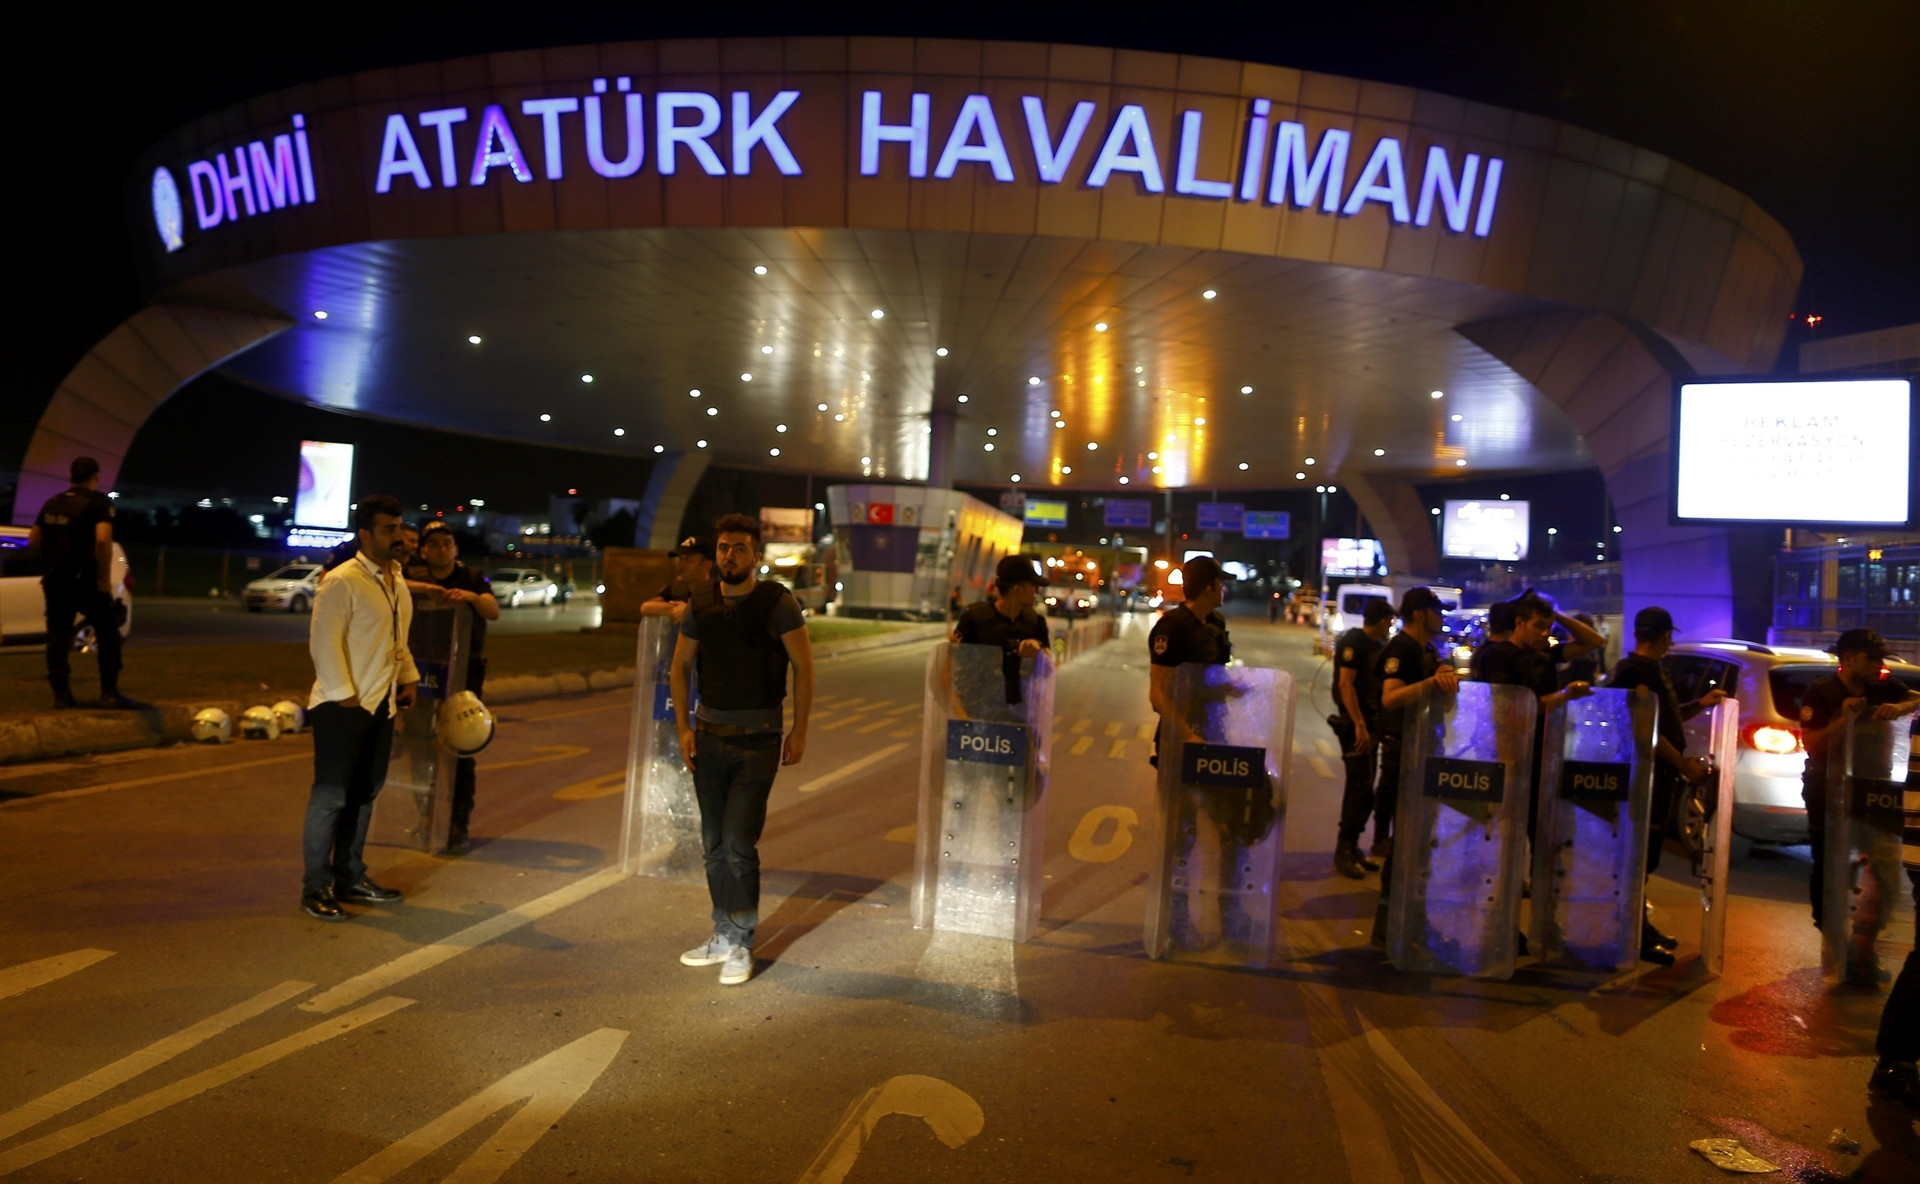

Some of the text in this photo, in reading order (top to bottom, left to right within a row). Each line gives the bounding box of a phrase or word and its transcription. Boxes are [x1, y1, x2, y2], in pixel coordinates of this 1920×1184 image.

[375, 76, 1504, 238] ATATÜRK HAVALİMANI
[187, 113, 316, 230] DHMİ
[1743, 415, 1839, 429] REKLAM
[960, 735, 1012, 754] POLİS
[1196, 757, 1250, 776] POLİS
[1438, 772, 1490, 790] POLİS
[1574, 773, 1618, 790] POLİS
[1865, 792, 1904, 809] POL
